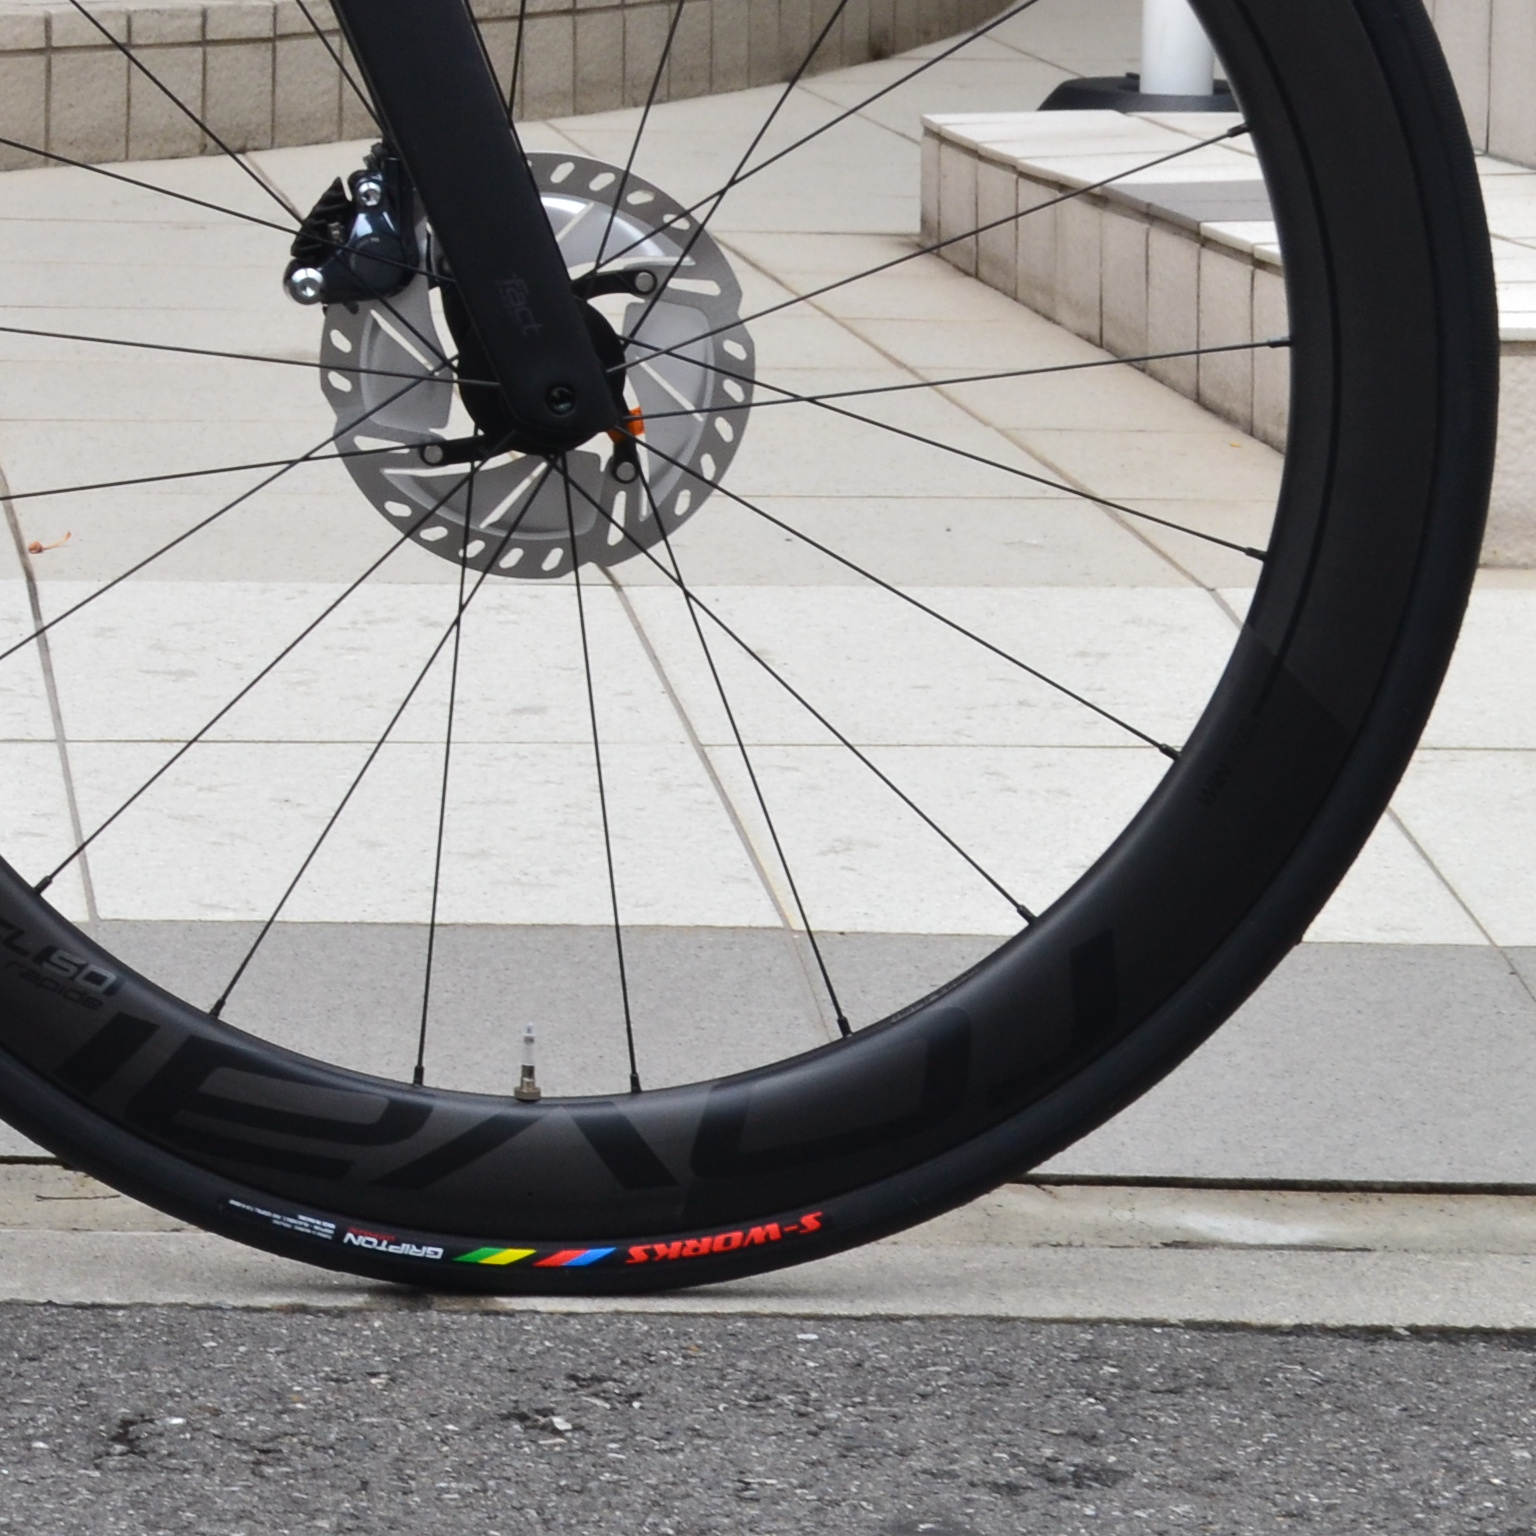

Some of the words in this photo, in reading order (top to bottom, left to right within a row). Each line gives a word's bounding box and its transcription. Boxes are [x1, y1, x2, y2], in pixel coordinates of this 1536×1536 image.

[3, 959, 104, 1012] rapide
[343, 1231, 444, 1260] GRIPTON
[624, 1210, 824, 1265] S-WORKS
